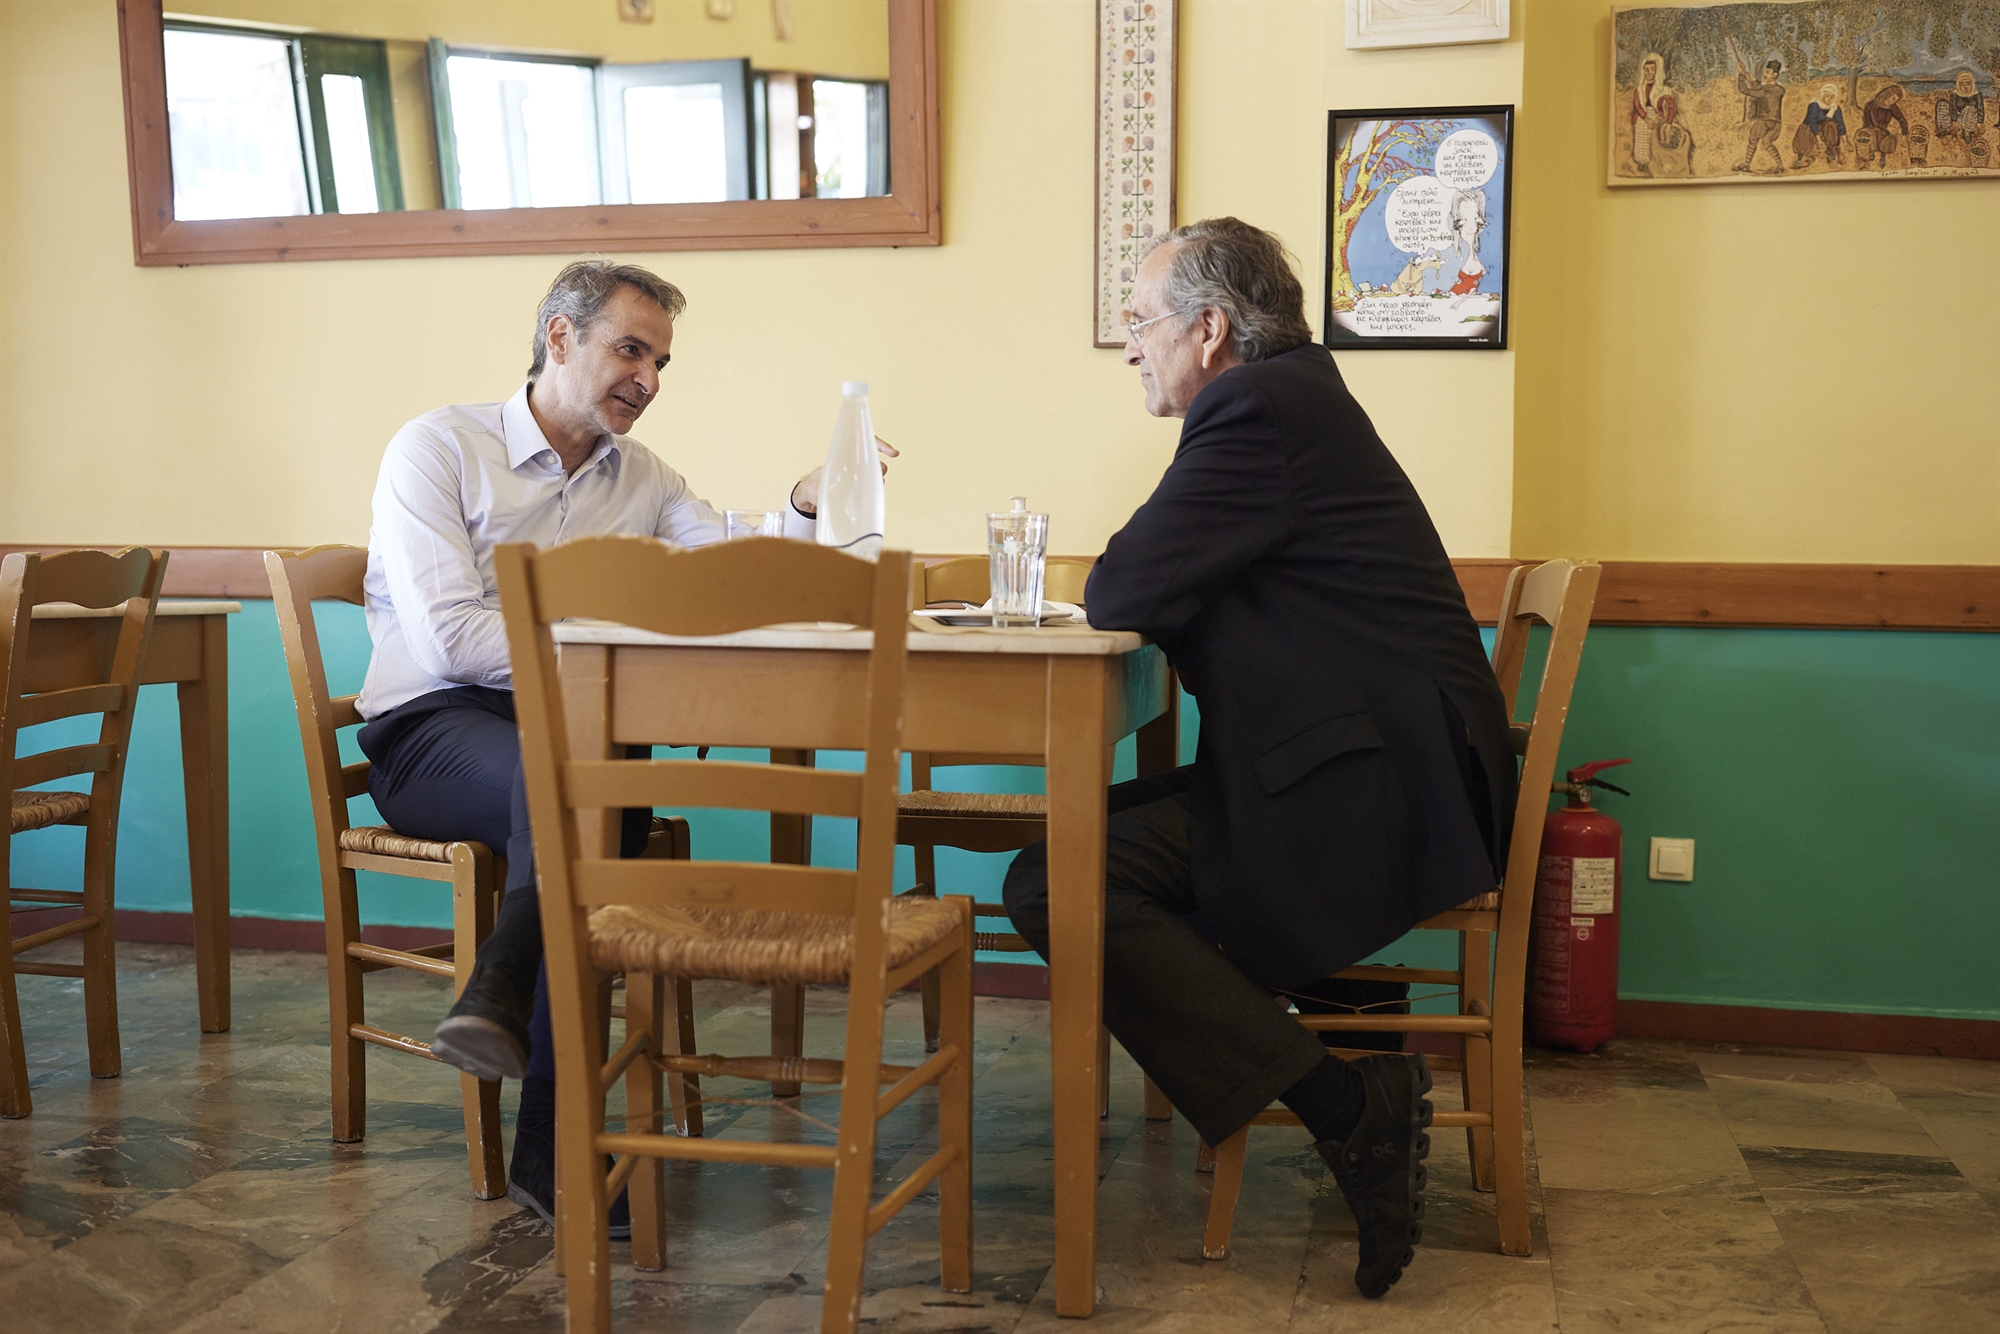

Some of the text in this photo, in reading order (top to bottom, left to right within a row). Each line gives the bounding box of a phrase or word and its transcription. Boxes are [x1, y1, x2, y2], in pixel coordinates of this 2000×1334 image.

[1421, 187, 1438, 196] πολύ
[1395, 218, 1426, 226] κεφτέδες
[1402, 299, 1432, 310] μεσημέρι
[1356, 316, 1366, 324] με
